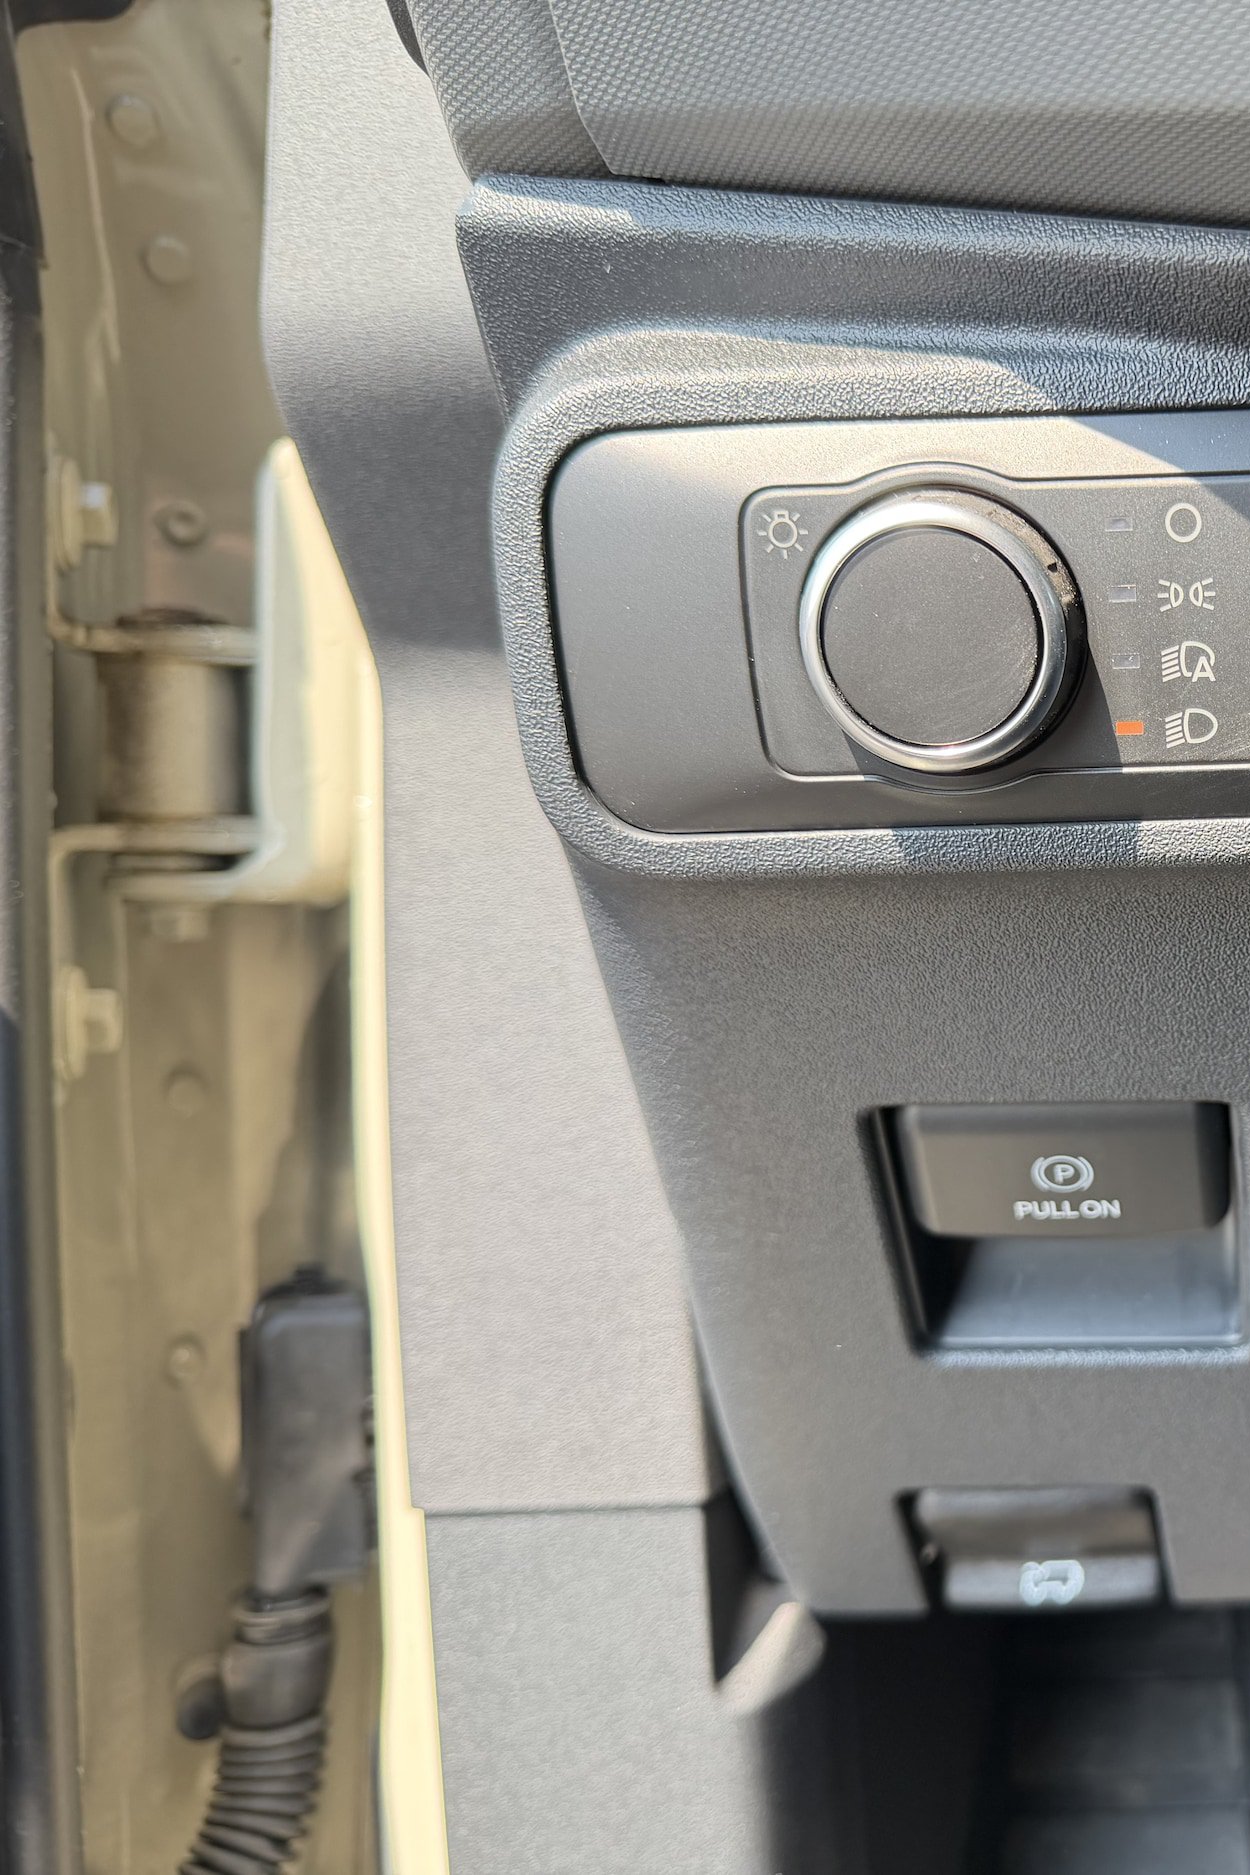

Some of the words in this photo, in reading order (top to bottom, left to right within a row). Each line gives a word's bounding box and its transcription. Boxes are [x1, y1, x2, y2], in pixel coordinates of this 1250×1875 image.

[1192, 656, 1216, 682] A
[1054, 1163, 1075, 1184] P
[1013, 1200, 1079, 1220] PULL
[1079, 1199, 1122, 1219] ON
